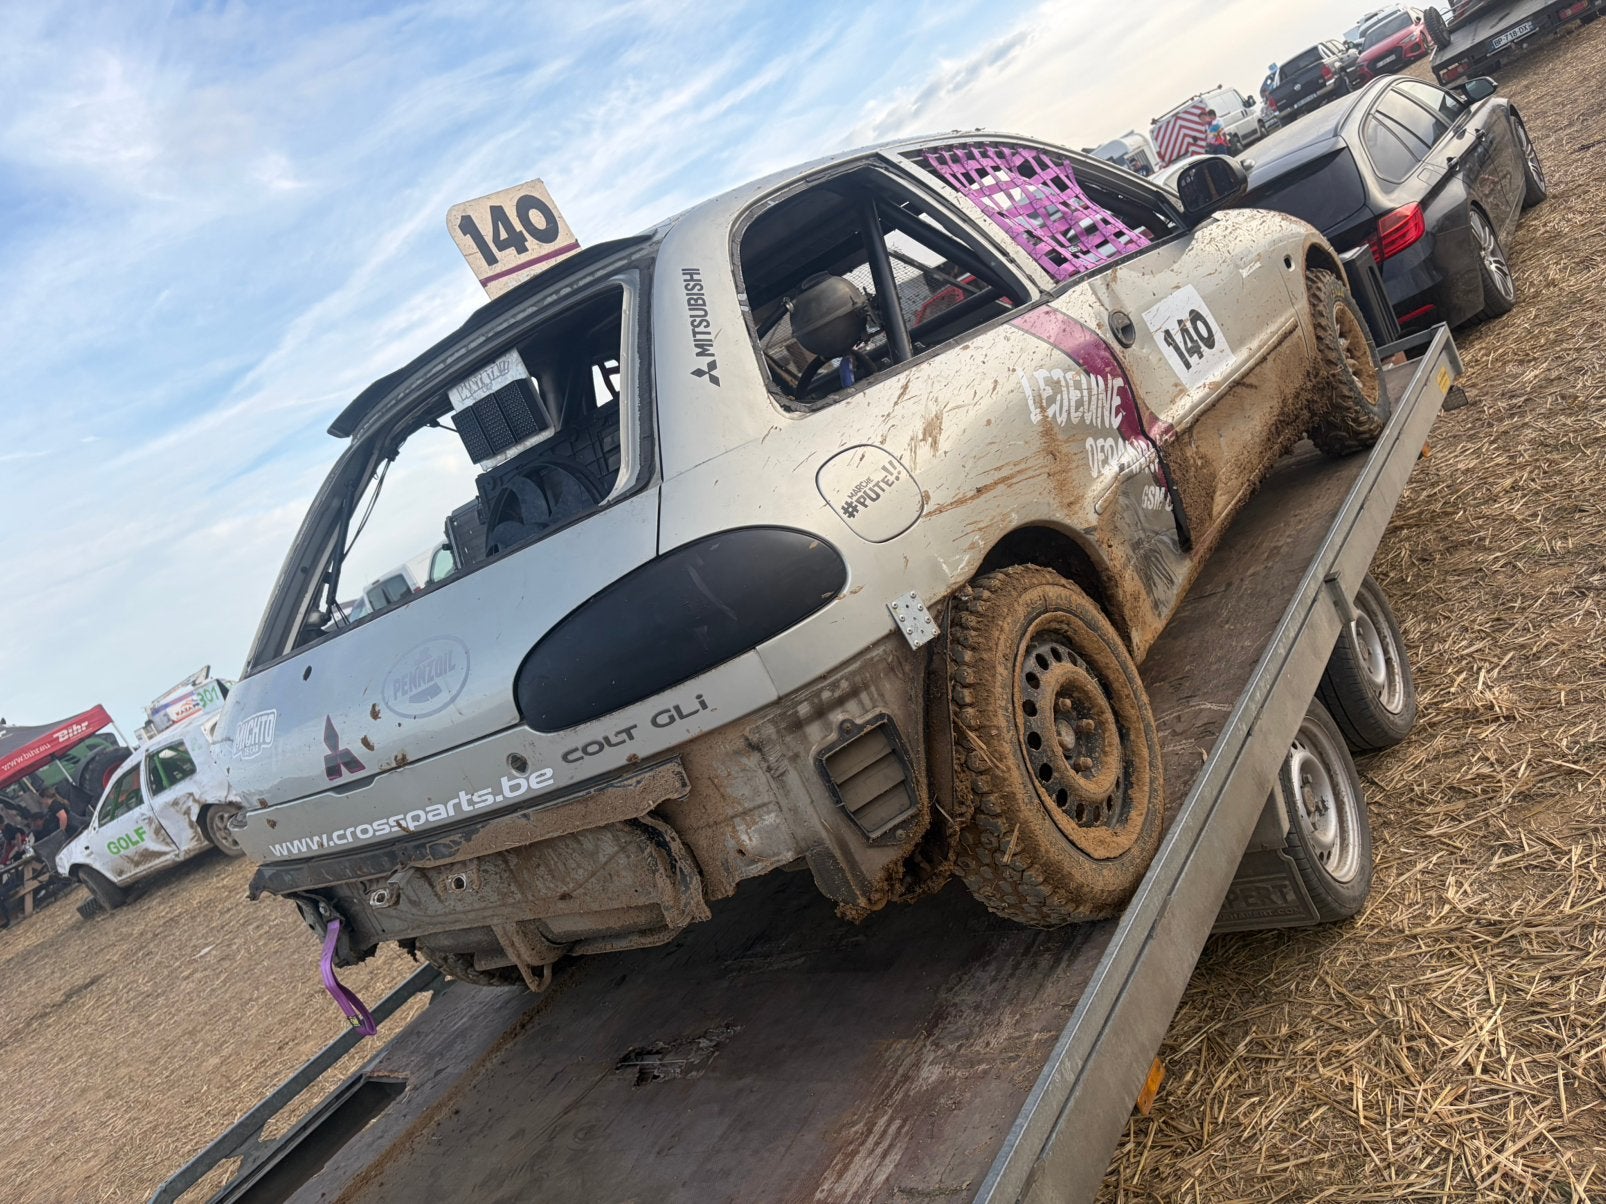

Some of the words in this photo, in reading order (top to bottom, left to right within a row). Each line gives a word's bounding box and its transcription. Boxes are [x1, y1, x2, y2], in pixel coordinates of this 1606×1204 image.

[457, 194, 559, 268] 140
[681, 267, 714, 358] MITSUBISHI
[1163, 308, 1216, 371] 140
[1017, 368, 1126, 430] LEJEUNE
[841, 459, 902, 519] #PUTE!!
[847, 476, 874, 500] MARCHE
[197, 685, 220, 709] 301
[392, 649, 456, 701] PENNZOIL
[53, 721, 89, 743] Bihr
[561, 724, 638, 765] COLT
[269, 767, 554, 858] www.crossparts.be
[106, 826, 147, 856] GOLF
